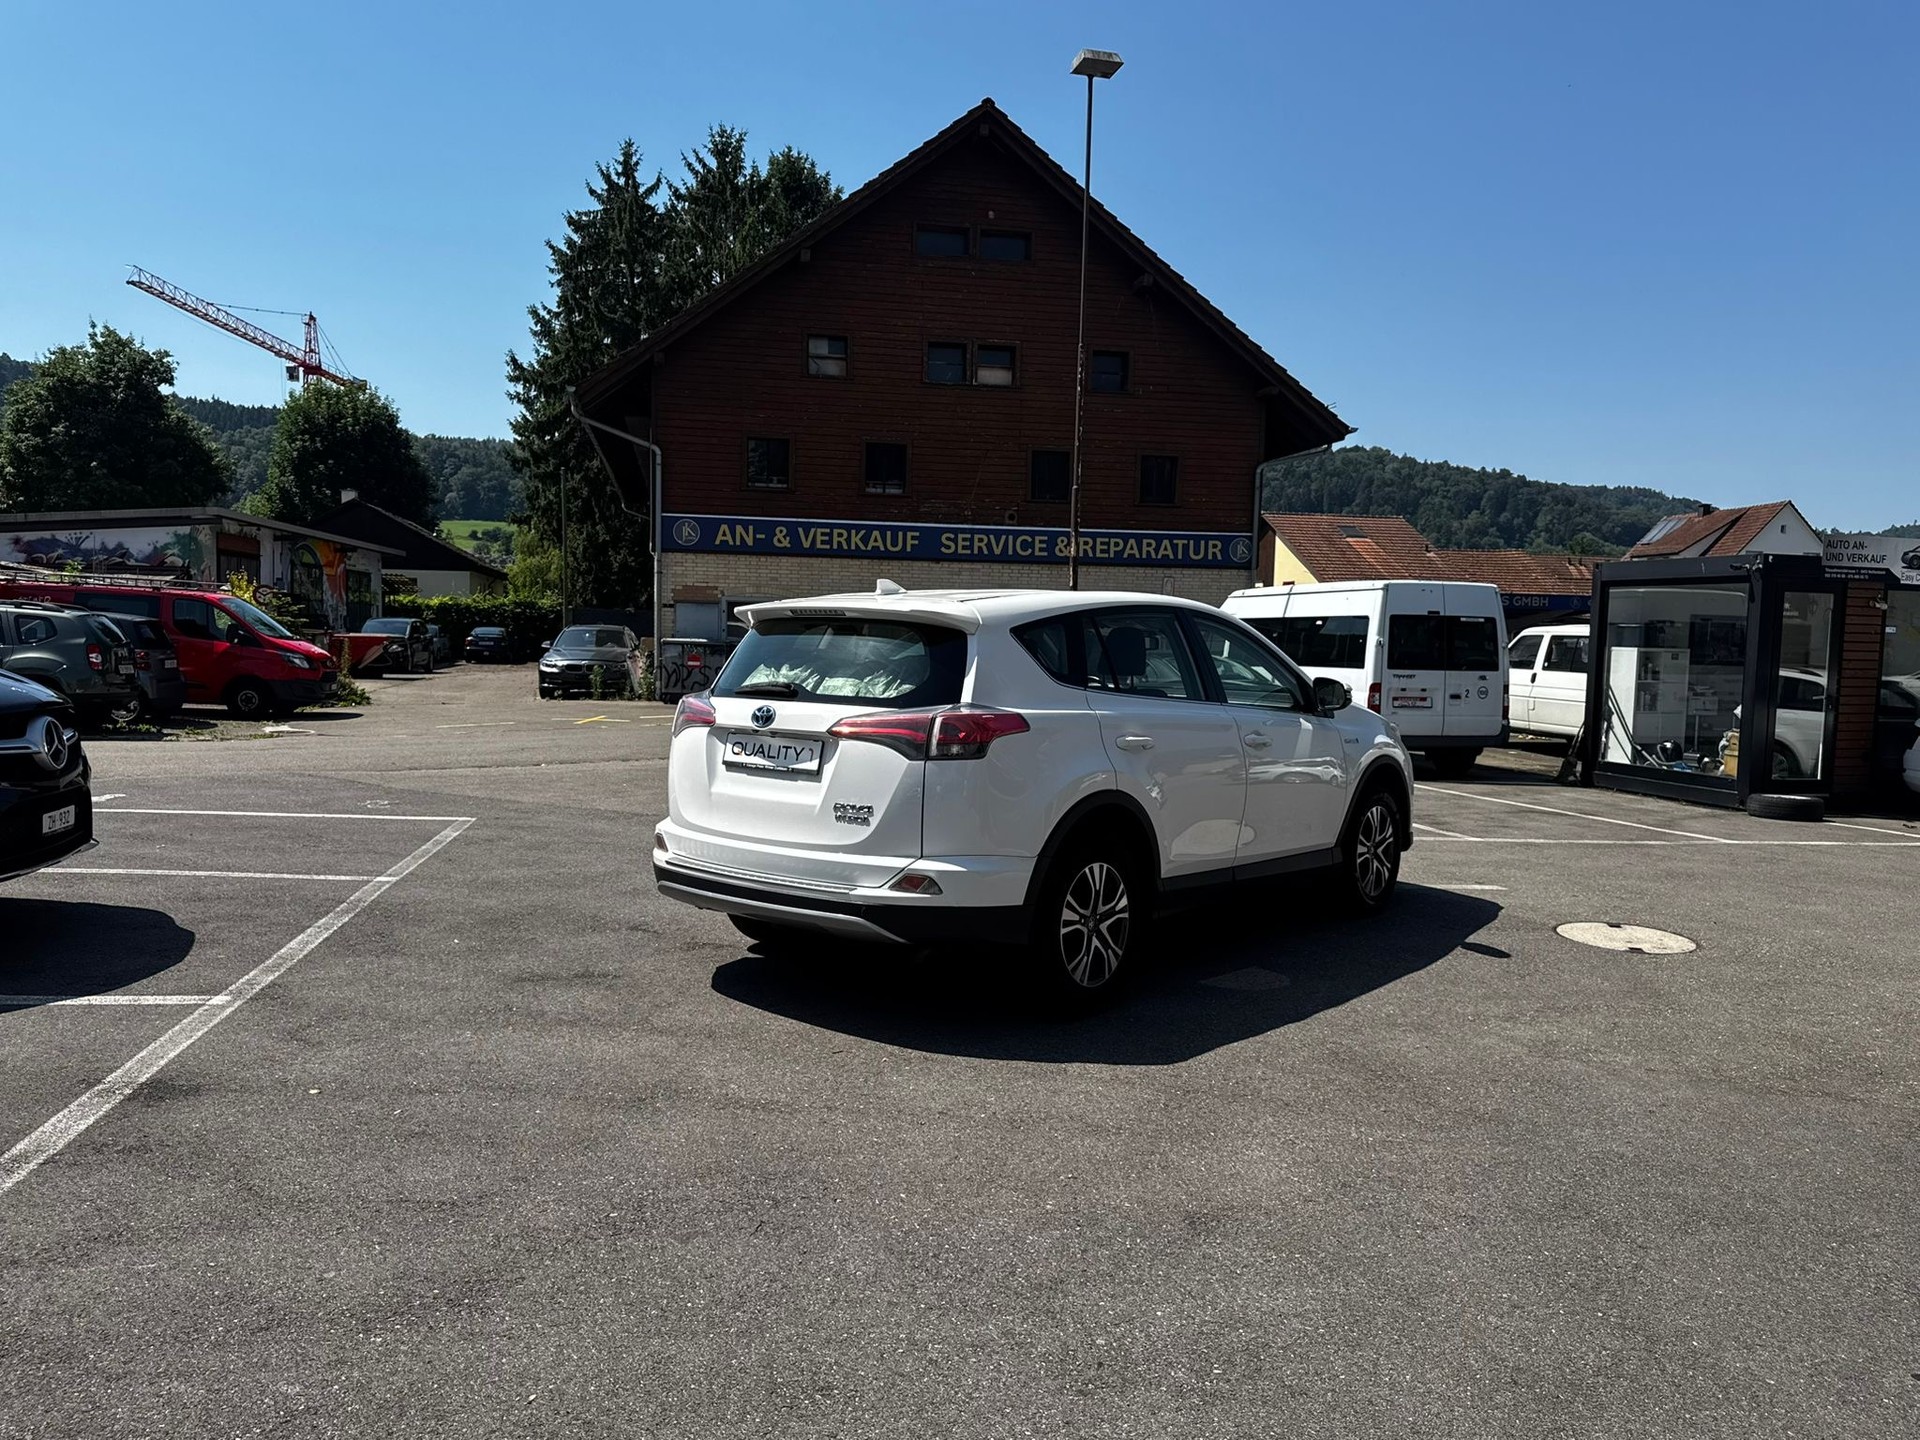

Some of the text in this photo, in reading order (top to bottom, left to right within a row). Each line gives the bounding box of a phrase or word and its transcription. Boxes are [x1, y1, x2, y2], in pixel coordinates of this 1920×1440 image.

[714, 523, 1223, 561] AN- & VERKAUF SERVICE & REPARATUR
[1826, 540, 1868, 550] AUTO AN-
[1825, 552, 1887, 563] UND VERKAUF
[1512, 595, 1549, 607] GMBH
[1464, 689, 1470, 698] 2
[731, 741, 806, 762] QUALITY
